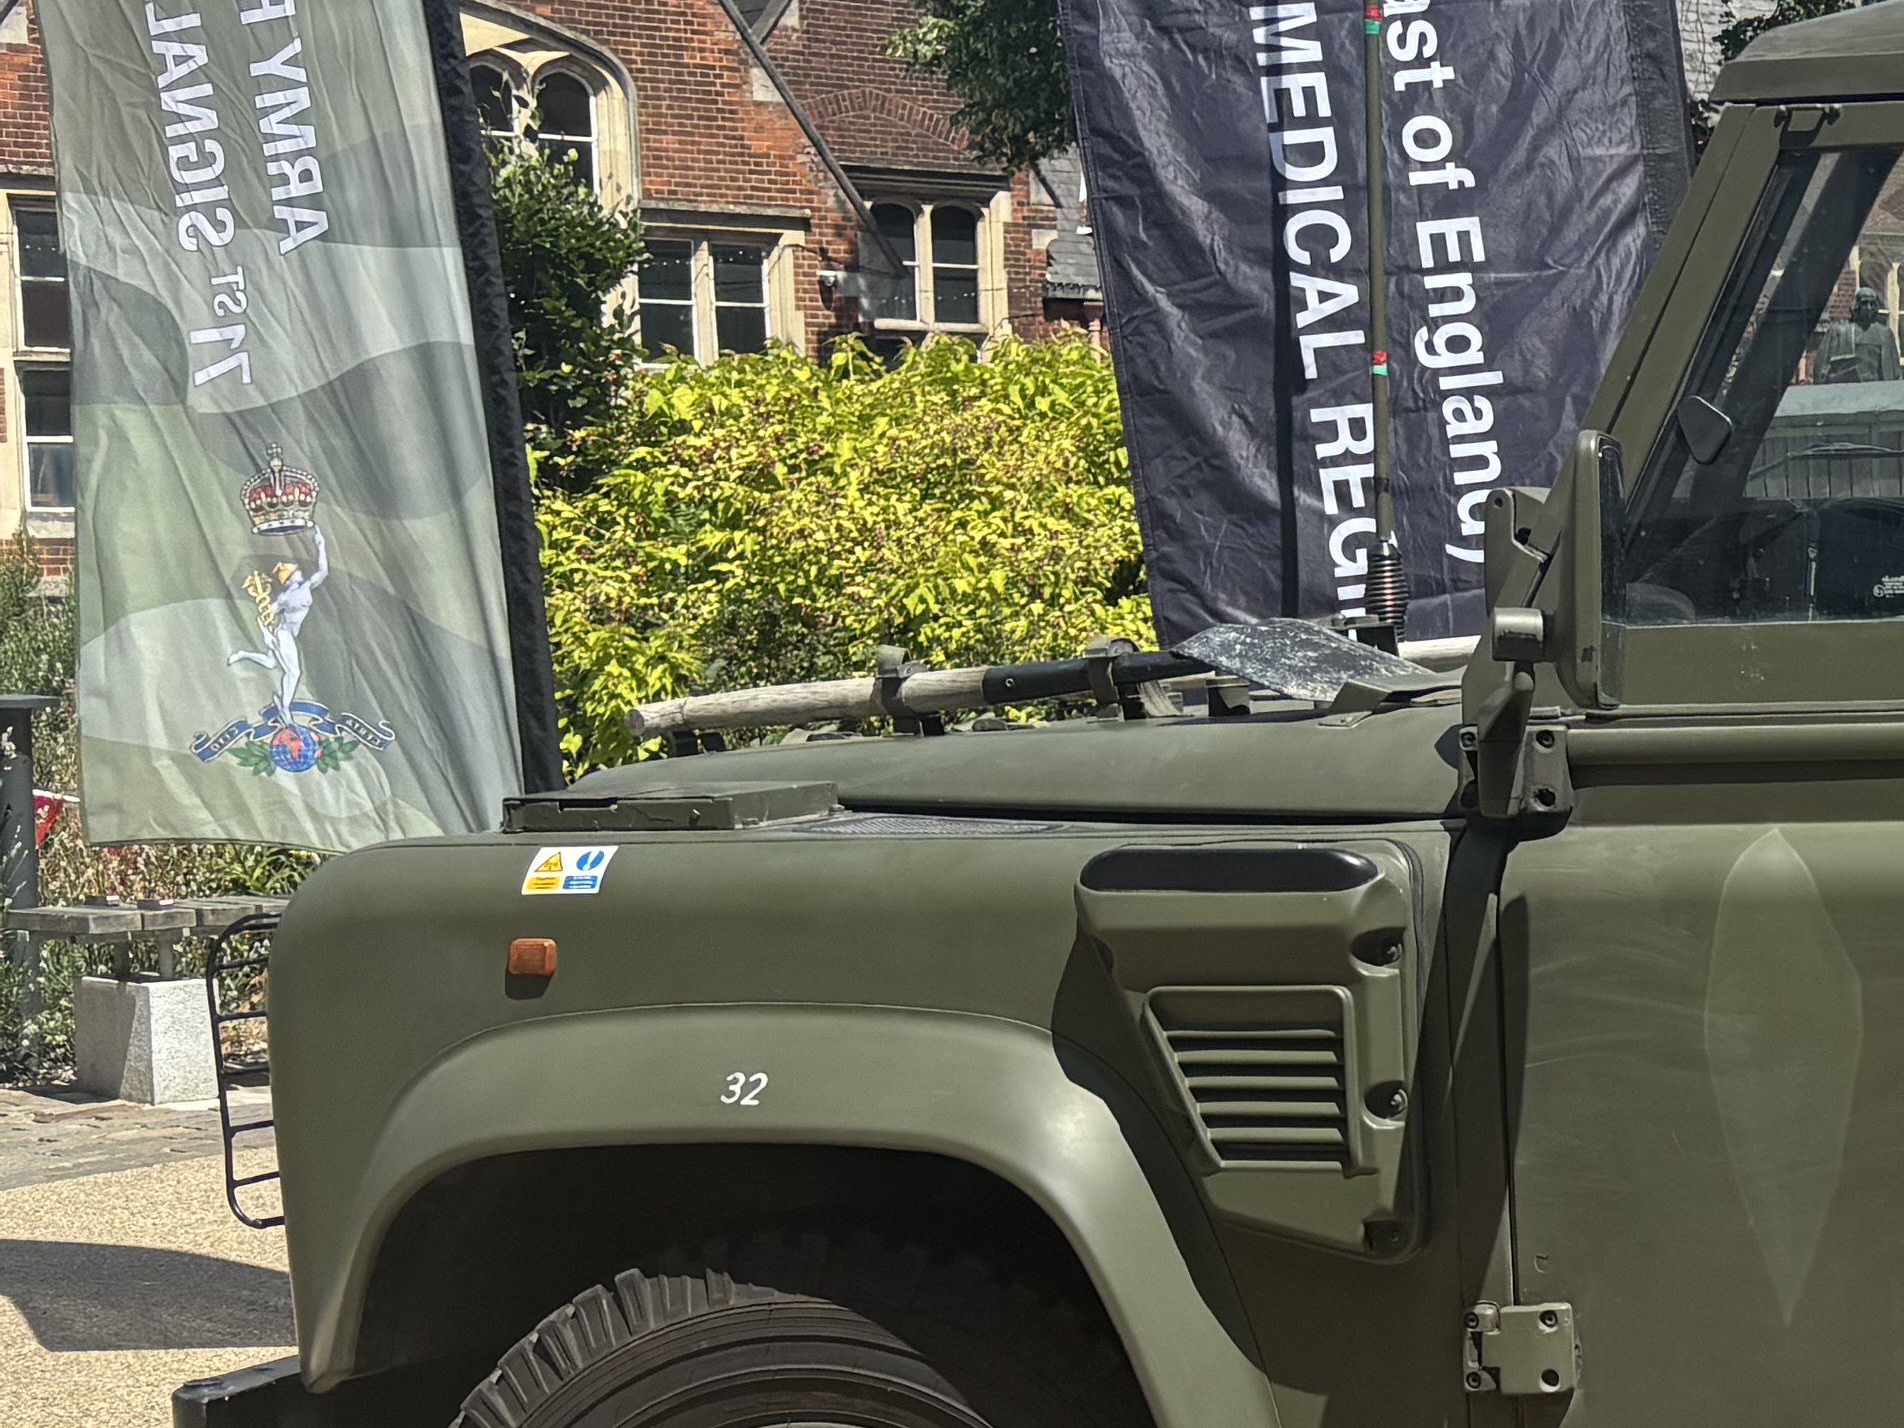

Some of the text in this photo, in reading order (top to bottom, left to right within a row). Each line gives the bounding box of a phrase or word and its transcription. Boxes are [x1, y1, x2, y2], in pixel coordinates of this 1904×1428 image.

[1401, 115, 1476, 190] of
[1249, 1, 1366, 380] MEDICAL
[720, 1072, 768, 1105] 32
